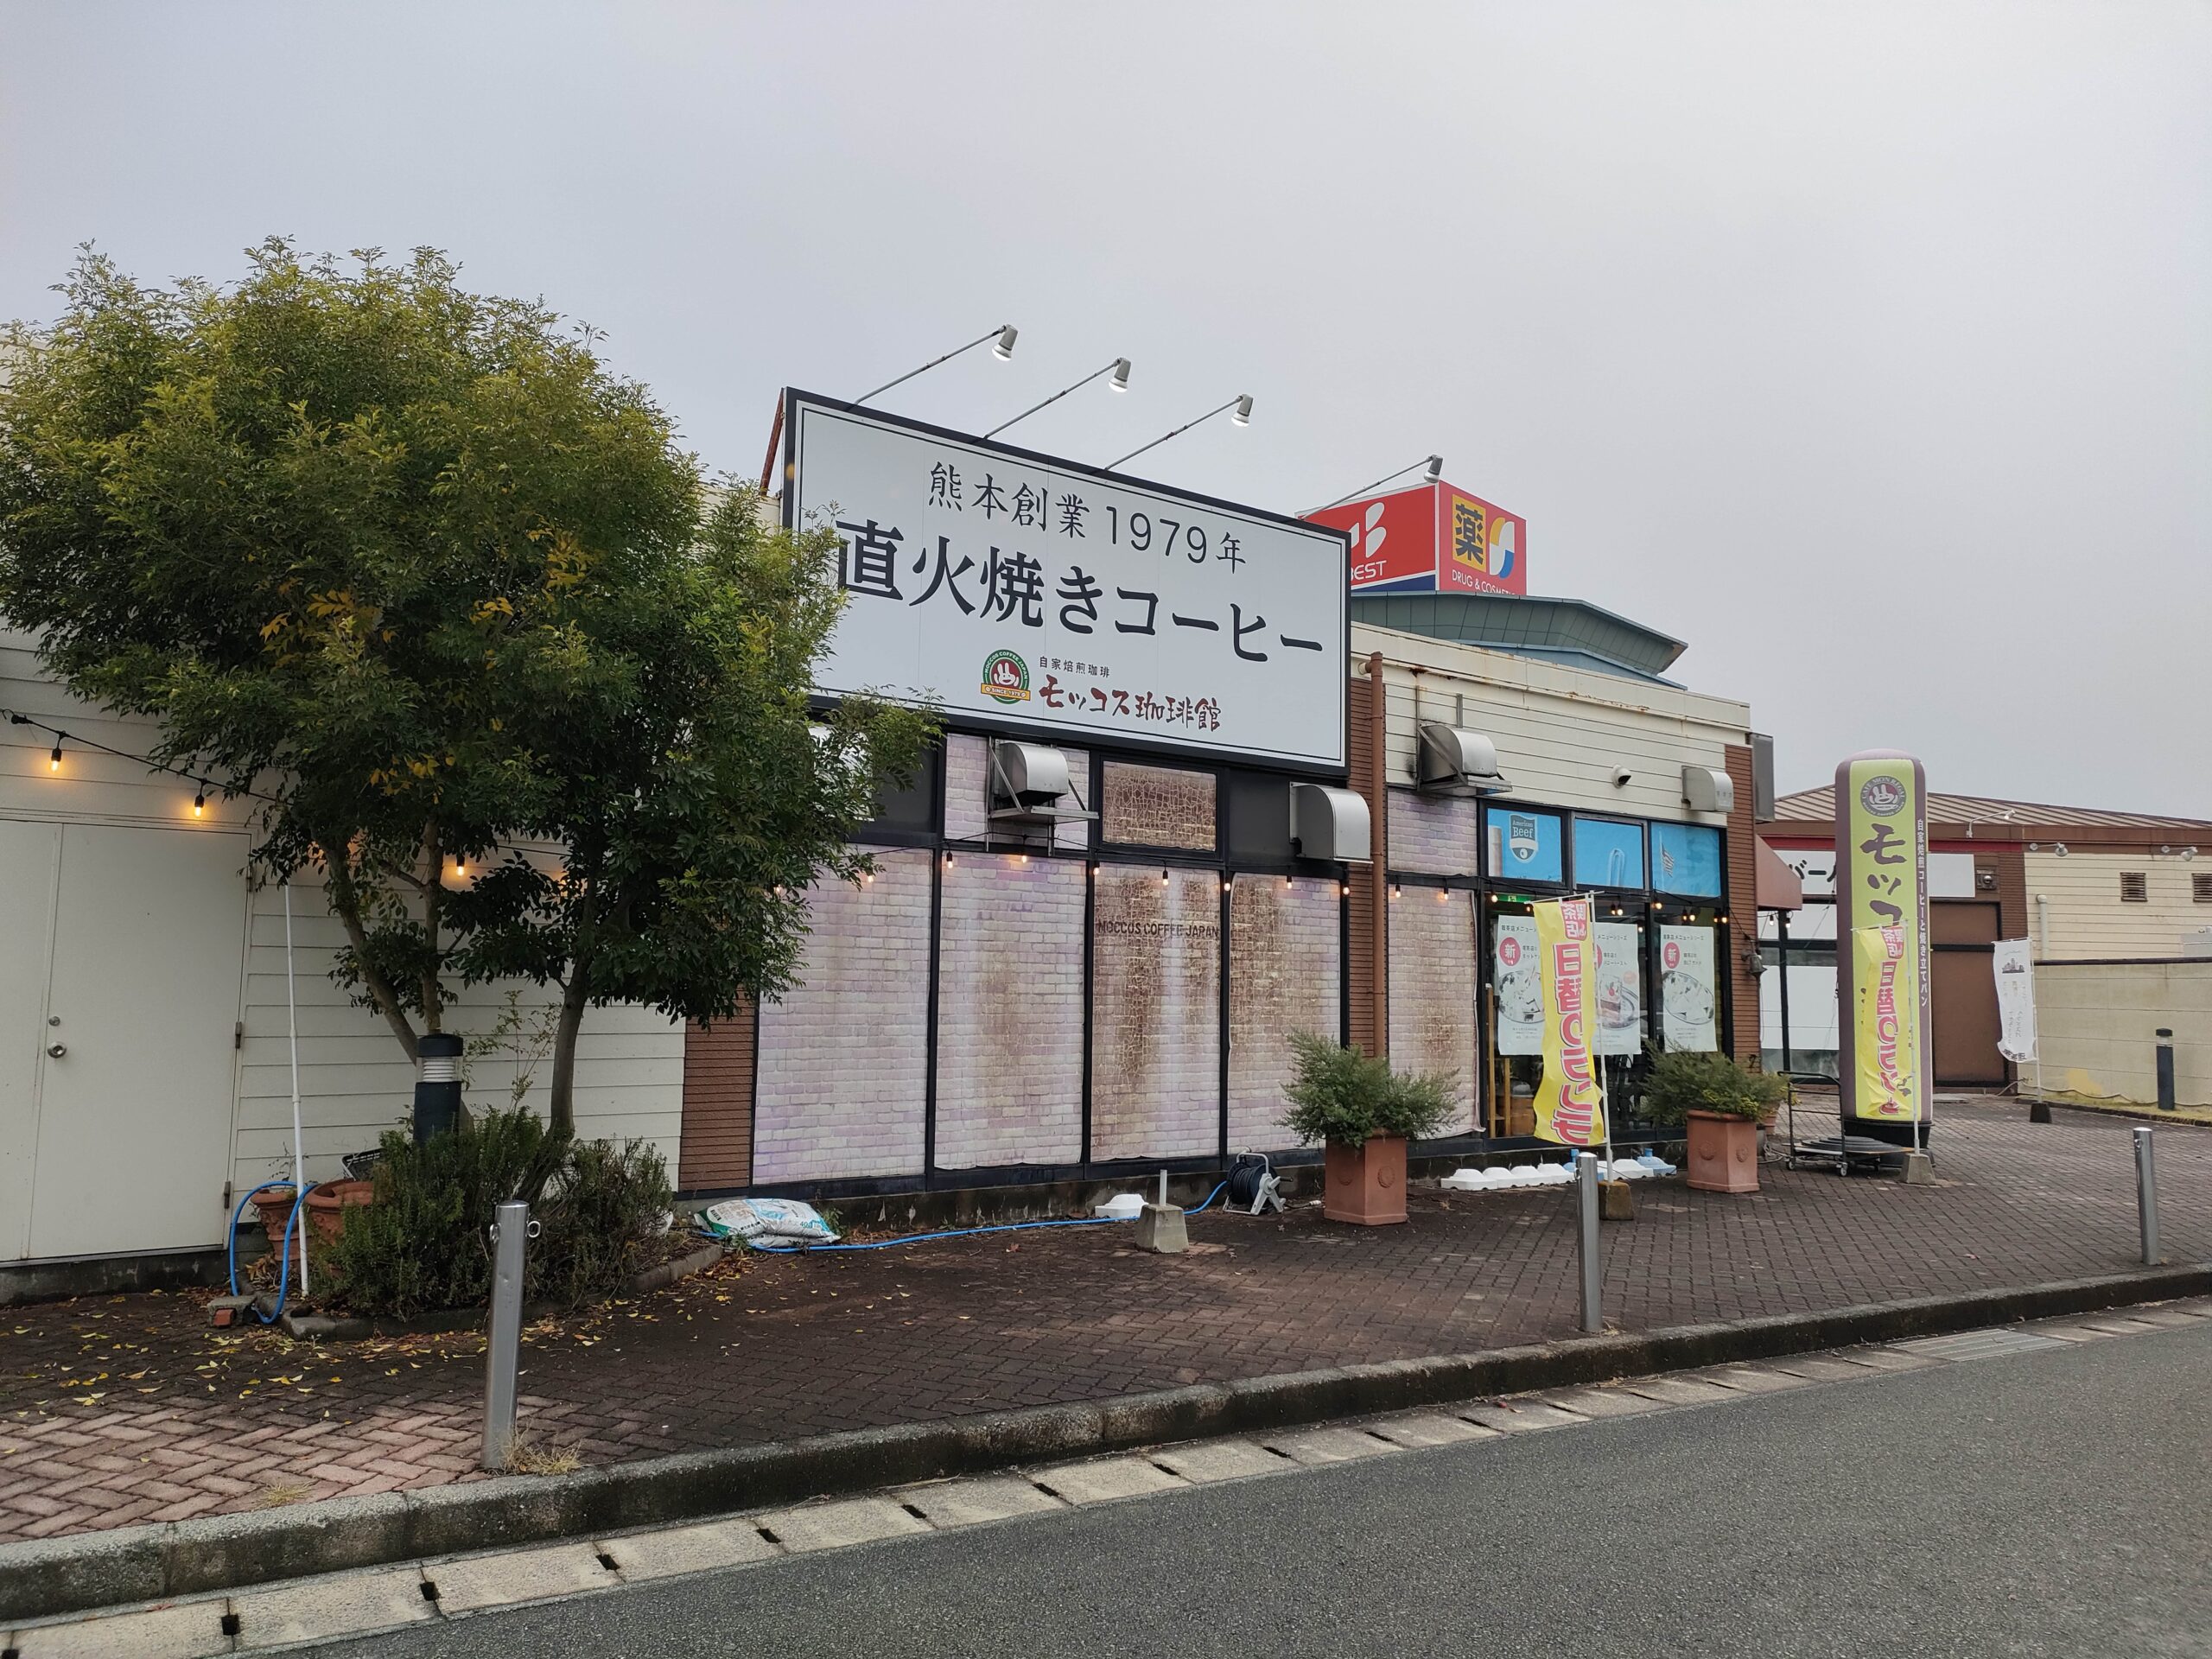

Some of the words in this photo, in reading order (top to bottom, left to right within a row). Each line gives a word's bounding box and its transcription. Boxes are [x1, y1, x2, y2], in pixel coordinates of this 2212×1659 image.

[1455, 503, 1484, 566] 薬
[835, 518, 1323, 662] 直火焼きコーヒー
[1452, 569, 1472, 588] DRUG
[1475, 580, 1481, 591] &
[984, 652, 999, 674] MOCCOS
[999, 651, 1020, 661] COFFEE
[1018, 661, 1028, 680] JAPAN
[1039, 656, 1110, 678] 自家焙煎珈琲
[1039, 674, 1221, 732] モッコス珈琲館
[1512, 826, 1534, 838] Beef
[1097, 920, 1141, 934] MOCCOS
[1143, 921, 1183, 936] COFFEE
[1185, 924, 1218, 938] JAPAN
